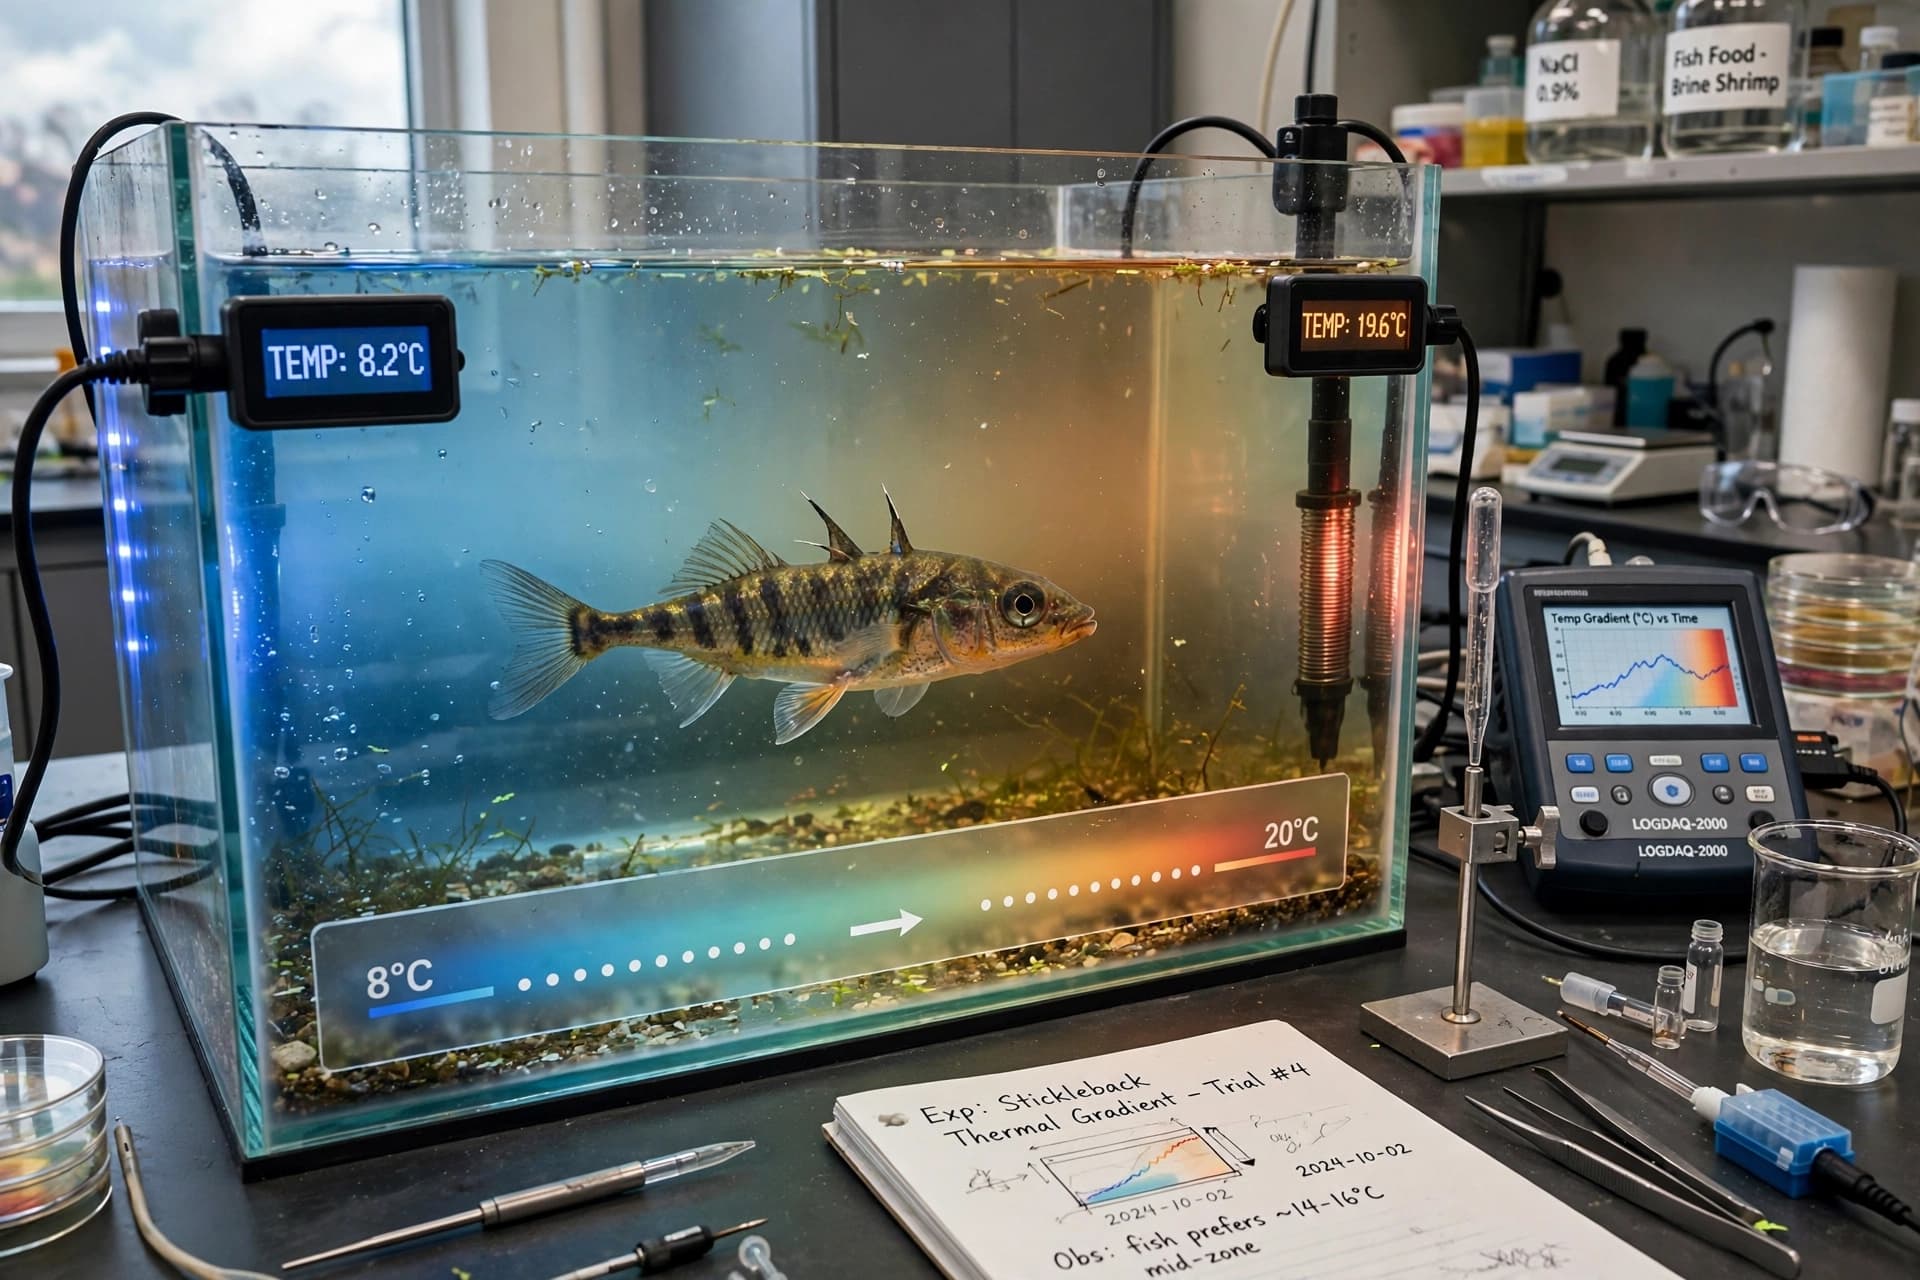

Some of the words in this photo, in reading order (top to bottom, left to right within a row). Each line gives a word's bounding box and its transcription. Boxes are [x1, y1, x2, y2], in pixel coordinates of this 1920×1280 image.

[1539, 53, 1579, 75] NaCl
[1674, 46, 1703, 68] Fish
[1709, 43, 1755, 65] Food
[1536, 81, 1580, 103] 0.9%
[1671, 76, 1711, 96] Brine
[1715, 71, 1780, 97] Shrimp
[1302, 312, 1350, 338] TEMP:
[1358, 311, 1407, 338] 19.6°C
[267, 344, 346, 380] TEMP:
[358, 342, 425, 377] 8.2°C
[1552, 612, 1581, 626] Temp
[1583, 612, 1630, 624] Gradient
[1656, 615, 1669, 624] vs
[1671, 612, 1698, 624] Time
[1264, 816, 1319, 849] 20°C
[1632, 817, 1728, 831] LOGDAQ-2000
[1638, 844, 1728, 857] LOGDAQ-2000
[367, 958, 433, 999] 8°C
[920, 1102, 987, 1125] Exp:
[998, 1073, 1151, 1112] Stickleback
[944, 1113, 1061, 1147] Thermal
[1072, 1091, 1178, 1124] Gradient
[1202, 1071, 1265, 1095] Trial
[1270, 1062, 1311, 1081] #4
[1295, 1143, 1413, 1178] 2024-10-02
[1104, 1188, 1233, 1226] 2024-10-02
[1053, 1247, 1114, 1271] Obs:
[1126, 1231, 1178, 1256] fish
[1187, 1215, 1266, 1246] prefers
[1144, 1240, 1261, 1278] mid-zone
